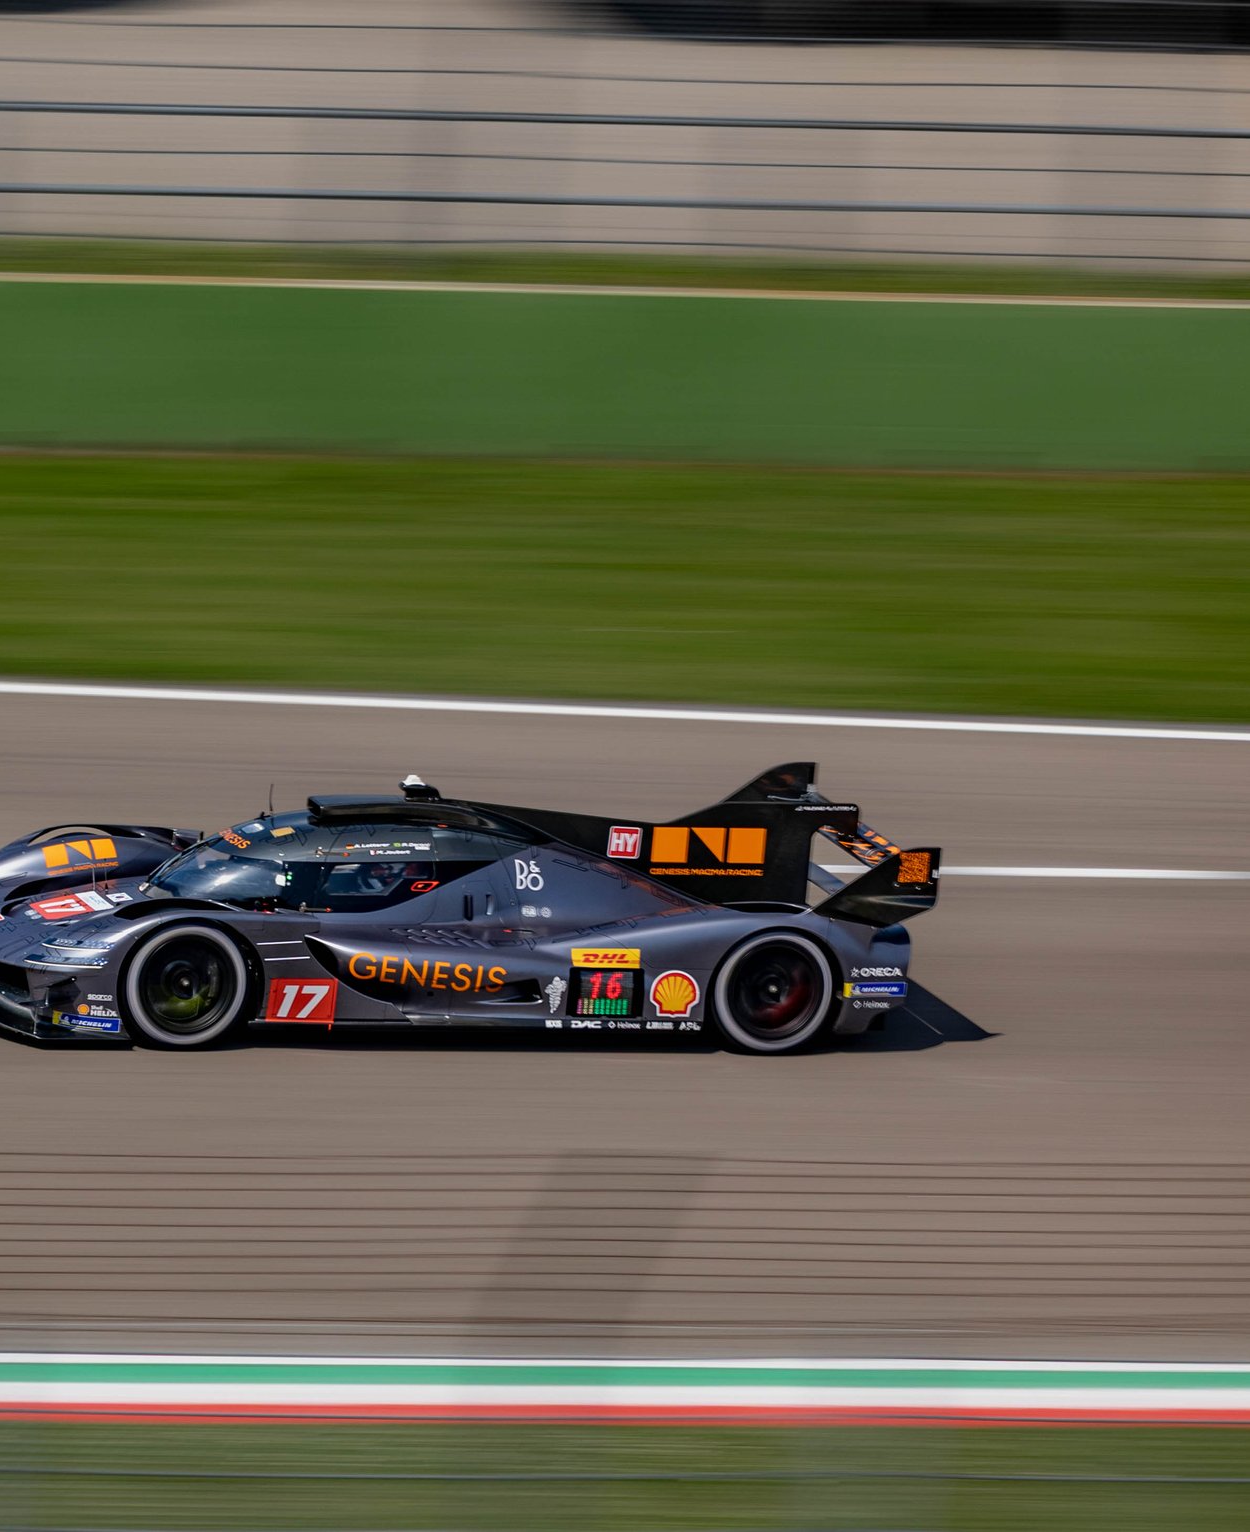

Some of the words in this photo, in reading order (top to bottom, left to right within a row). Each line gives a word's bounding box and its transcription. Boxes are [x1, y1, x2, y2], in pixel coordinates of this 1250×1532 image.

[610, 832, 638, 853] HY
[690, 868, 727, 876] MAGMA
[727, 868, 764, 877] RACING
[581, 953, 630, 964] DHL
[348, 952, 508, 993] GENESIS
[860, 967, 904, 977] ORECA
[589, 971, 624, 1000] 16
[276, 985, 330, 1019] 17
[862, 1000, 891, 1009] Helinox
[90, 1008, 119, 1017] HELIX
[70, 1019, 113, 1029] MICHELIN
[570, 1020, 602, 1029] DAC
